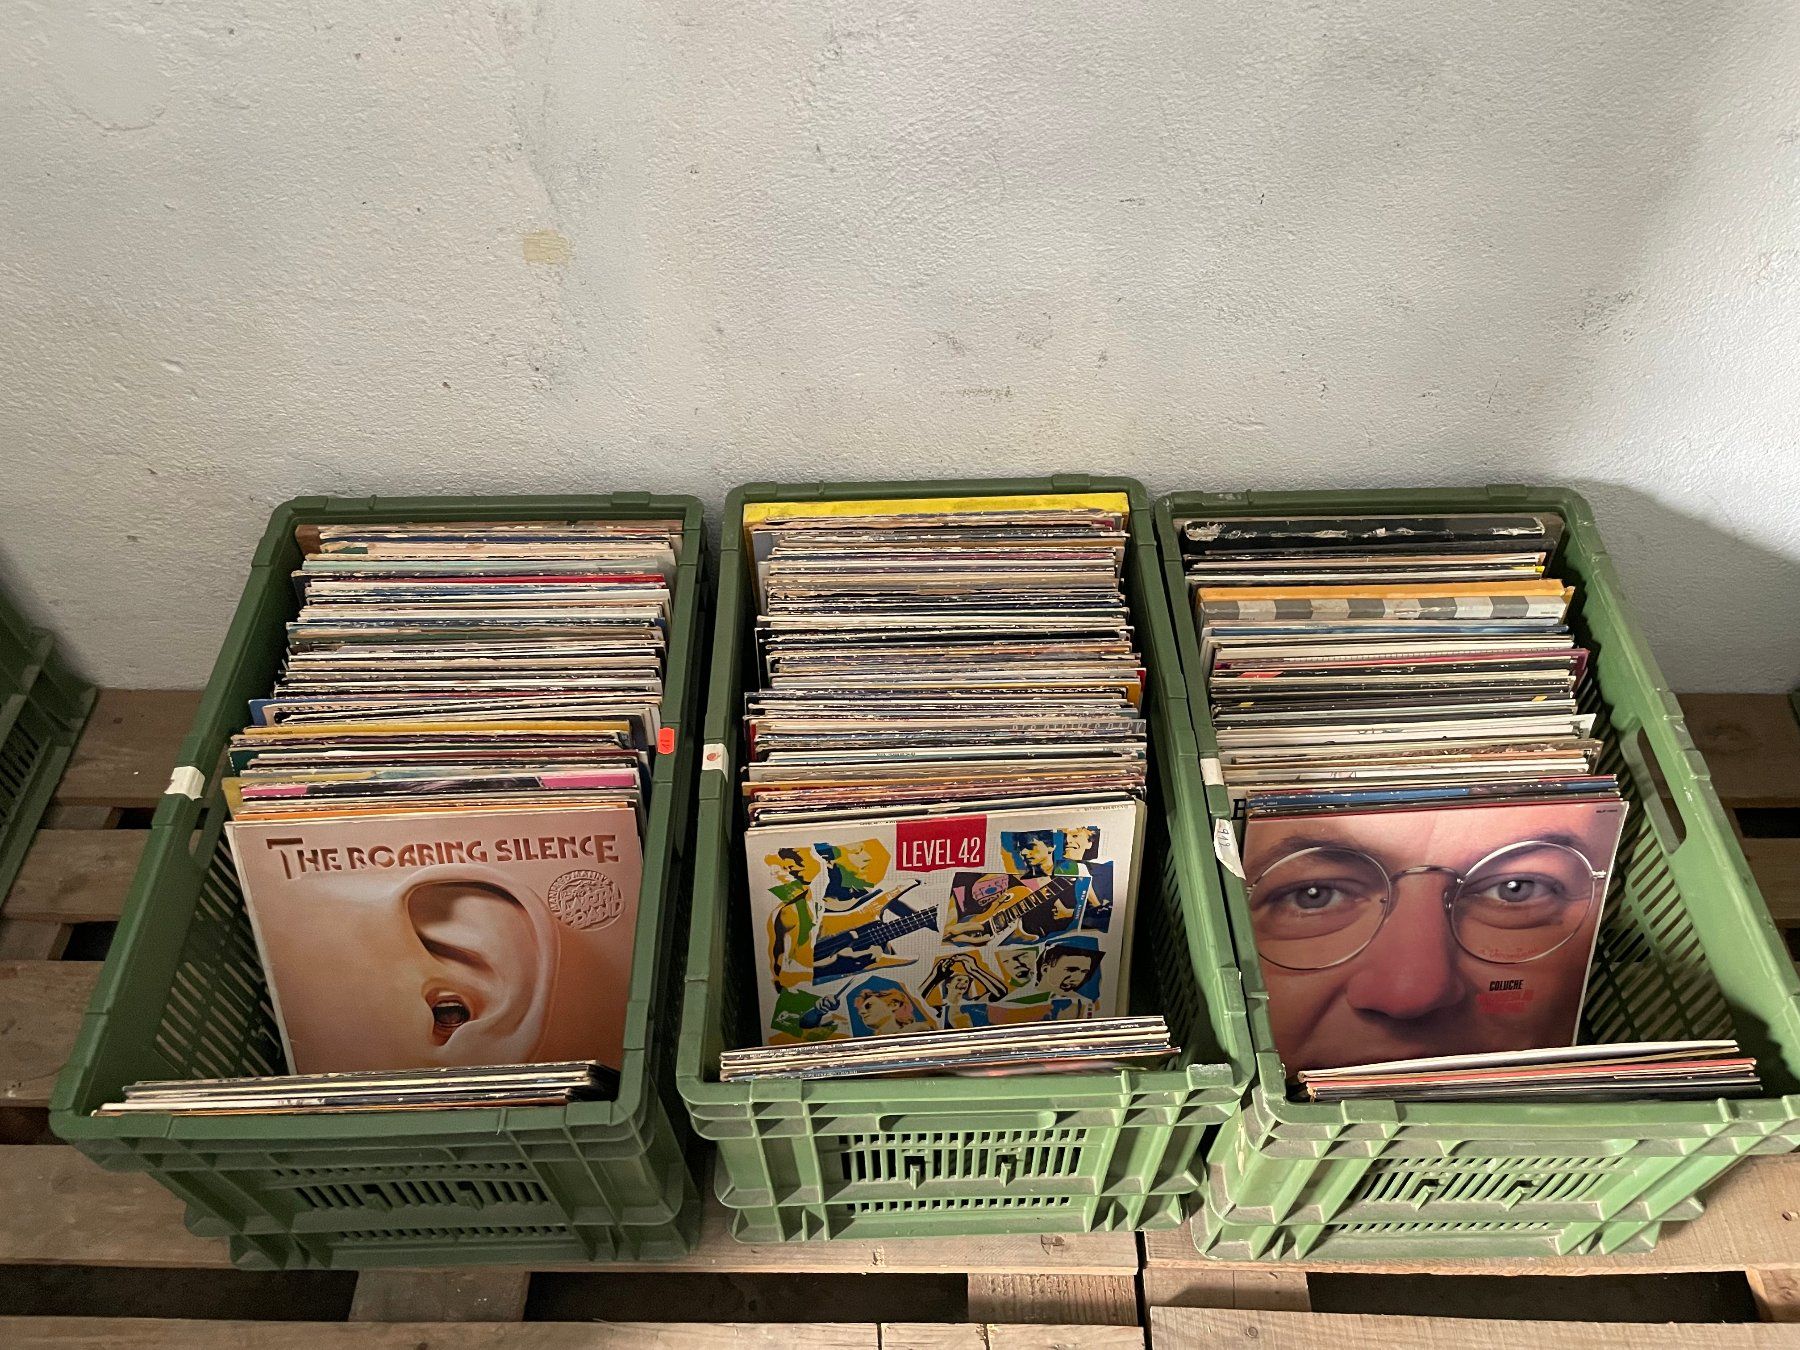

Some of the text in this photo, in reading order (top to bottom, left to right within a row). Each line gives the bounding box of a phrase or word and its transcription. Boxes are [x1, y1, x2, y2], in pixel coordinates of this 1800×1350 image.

[266, 835, 619, 880] THE ROARING SILENCE
[902, 837, 980, 867] LEVEL 42
[1489, 980, 1524, 991] COLUCHE
